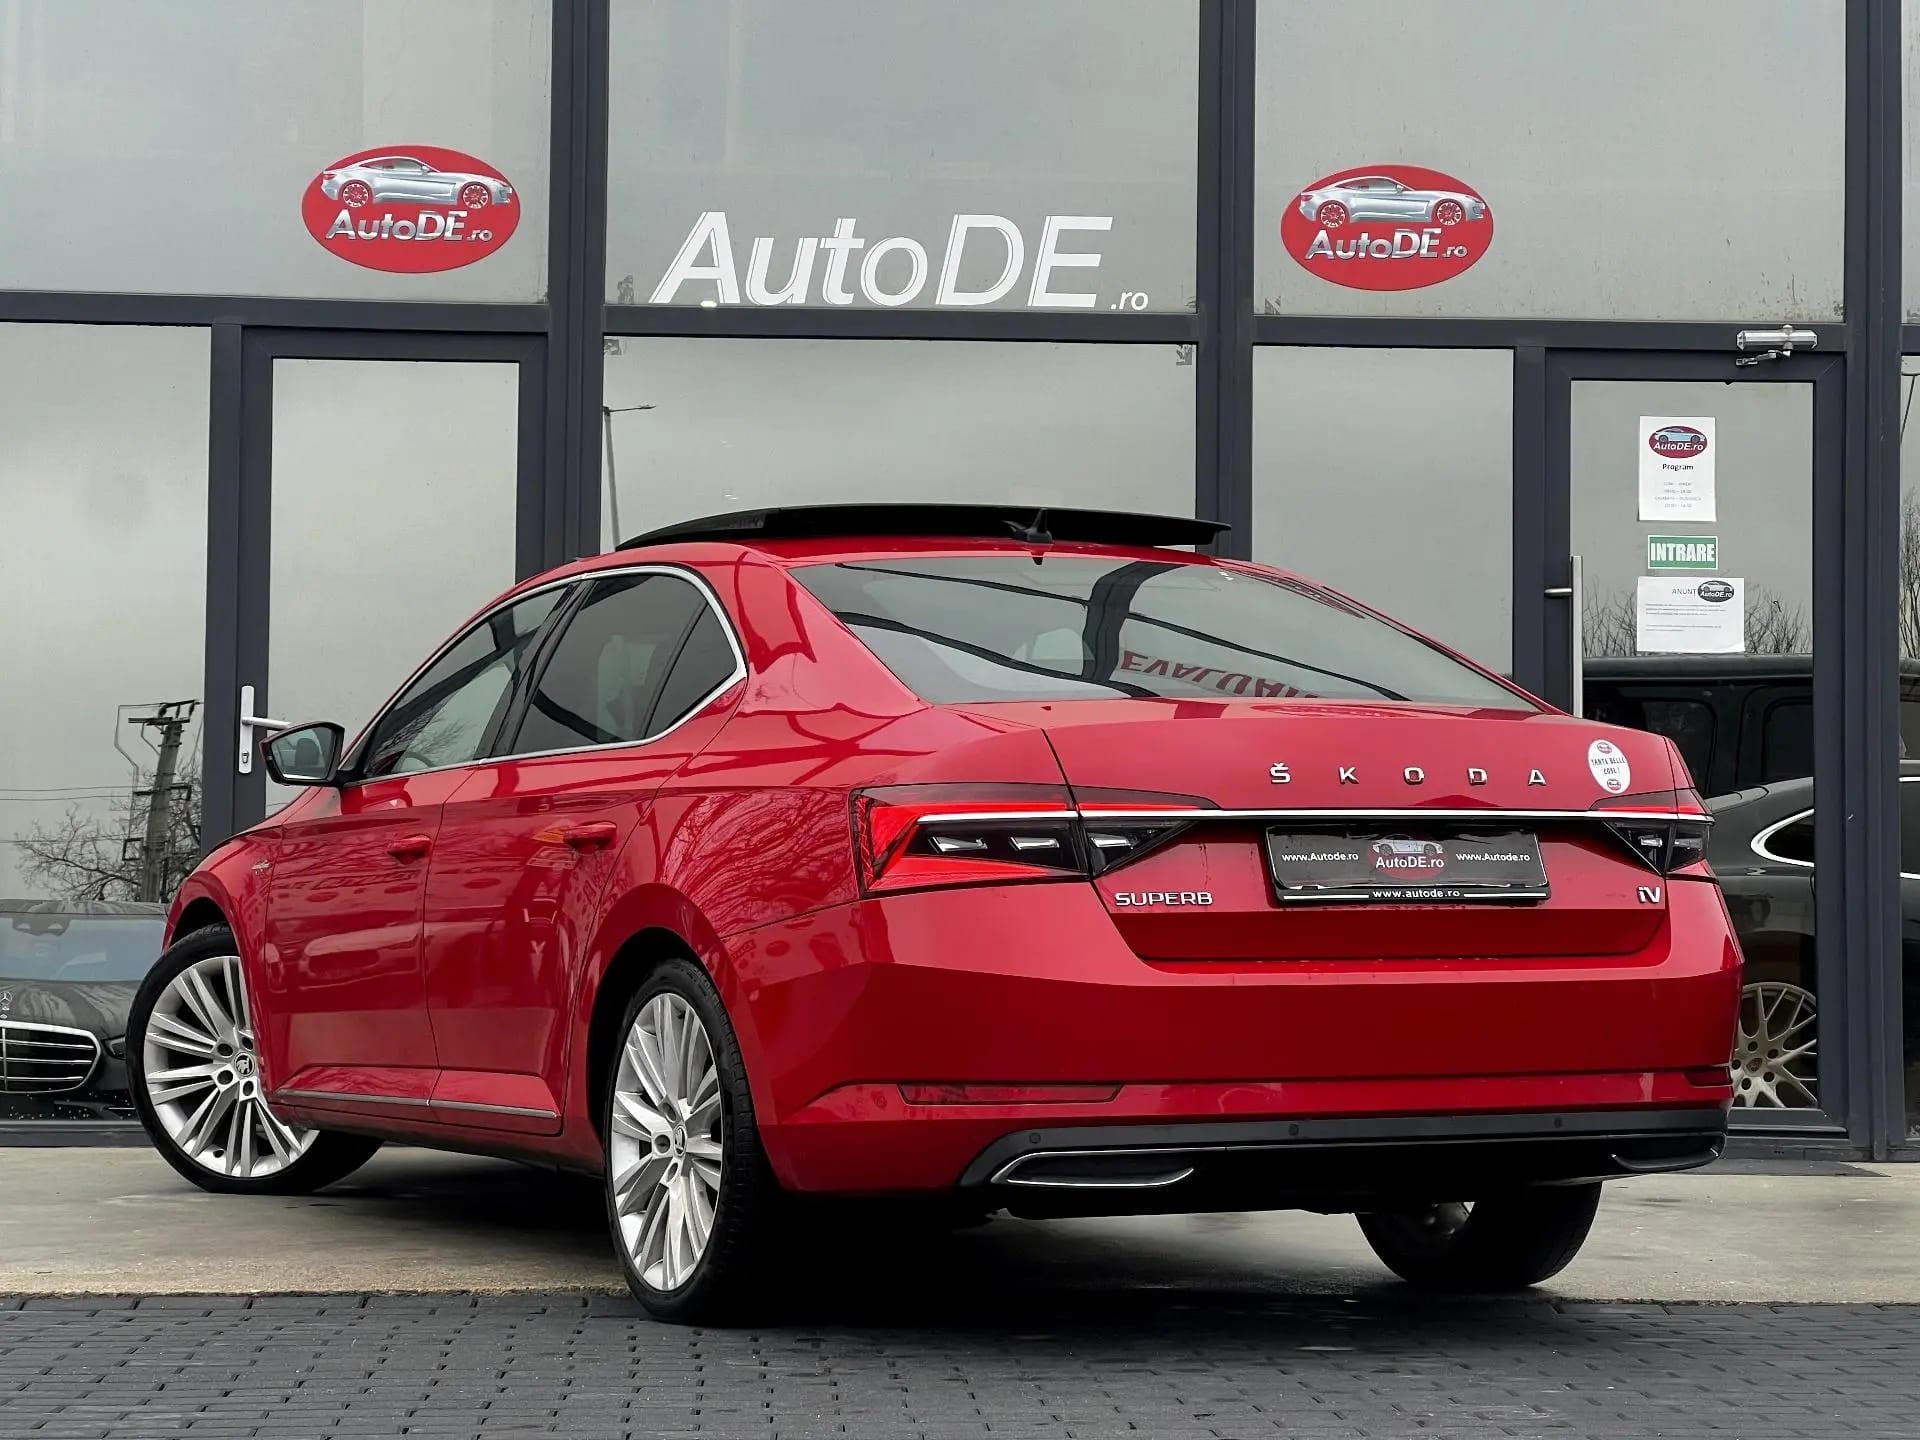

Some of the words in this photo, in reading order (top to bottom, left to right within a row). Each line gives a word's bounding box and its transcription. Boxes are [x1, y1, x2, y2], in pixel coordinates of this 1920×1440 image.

[325, 209, 493, 242] AutoDE.ro
[1305, 228, 1469, 260] AutoDE.ro
[1653, 442, 1704, 451] AutoDE.ro
[1662, 463, 1694, 471] Program
[1650, 543, 1715, 562] INTRARE
[1281, 851, 1359, 862] www.Autode.ro
[1375, 855, 1445, 869] AutoDE.ro
[1456, 852, 1531, 862] www.Autode.ro
[1114, 891, 1213, 906] SUPERB
[1372, 889, 1460, 898] www.autode.ro
